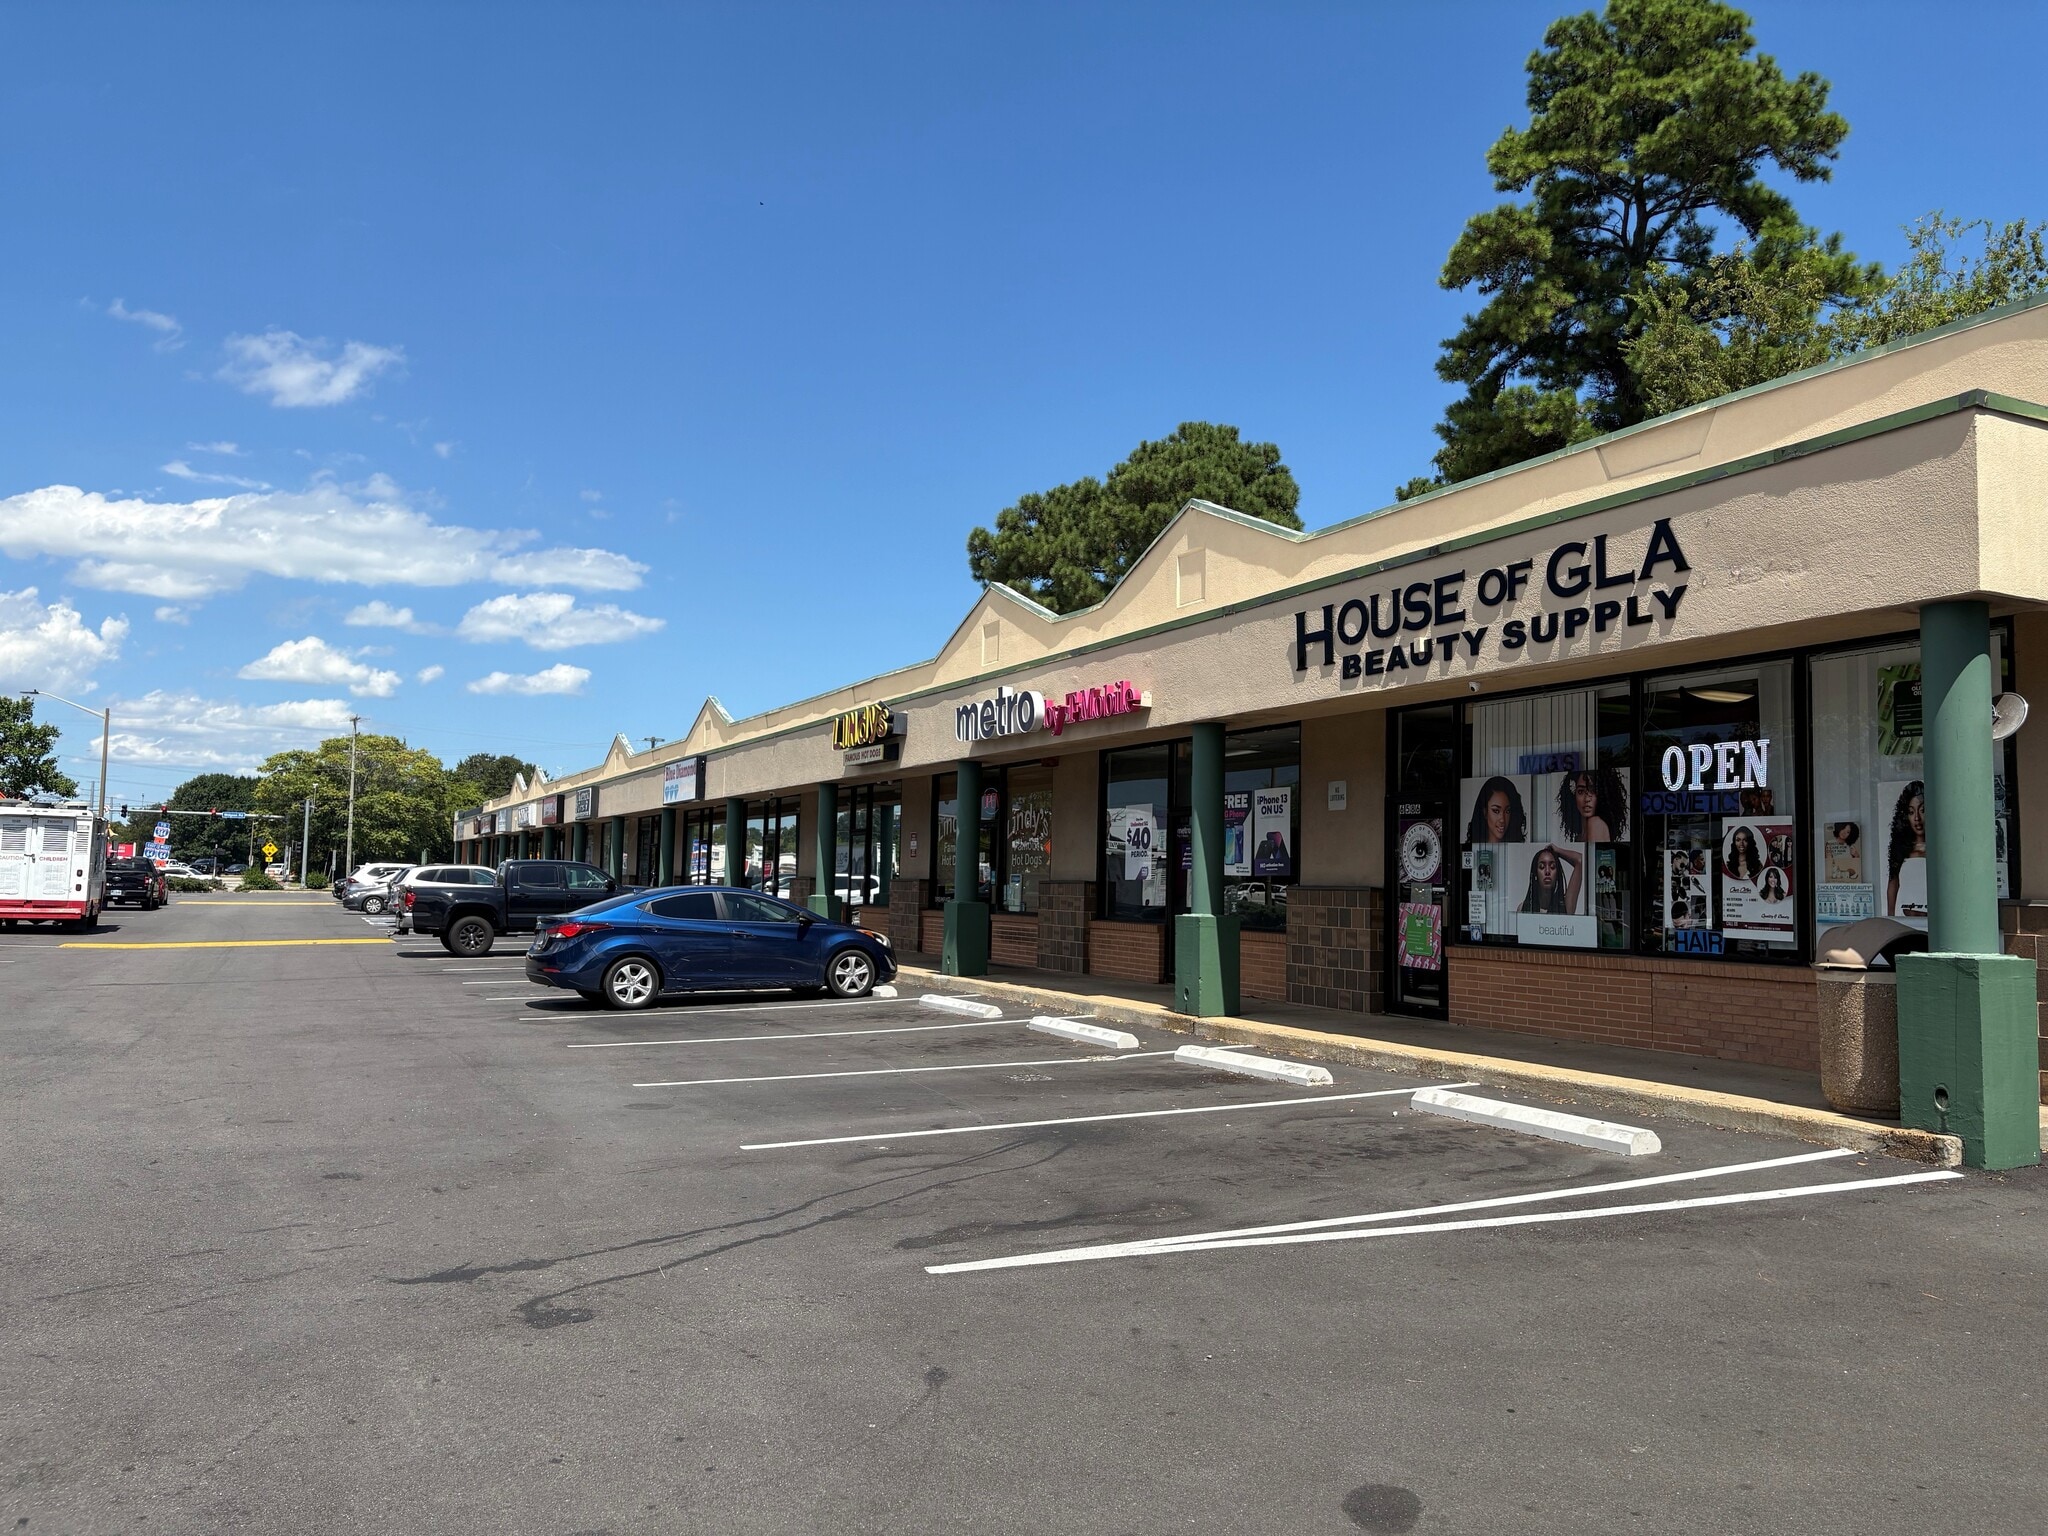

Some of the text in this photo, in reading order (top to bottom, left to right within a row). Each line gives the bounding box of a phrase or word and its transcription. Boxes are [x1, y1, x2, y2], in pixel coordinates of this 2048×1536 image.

[1294, 518, 1692, 671] HOUSE OF GLA
[1342, 584, 1688, 680] BEAUTY SUPPLY
[956, 681, 1138, 742] metro by T-Mobile
[845, 748, 881, 762] FAMOUS HOT DOGS
[1520, 754, 1575, 774] WIGS
[1661, 739, 1770, 792] OPEN
[1257, 794, 1288, 805] iPhone 13
[1641, 792, 1738, 812] COSMETICS
[1261, 805, 1283, 815] ON US
[1007, 804, 1050, 840] Lindy's
[944, 842, 956, 852] Fam
[1127, 827, 1151, 850] $40
[1011, 854, 1042, 868] Hot Dogs
[1538, 924, 1574, 936] beautiful
[1675, 930, 1722, 952] HAIR
